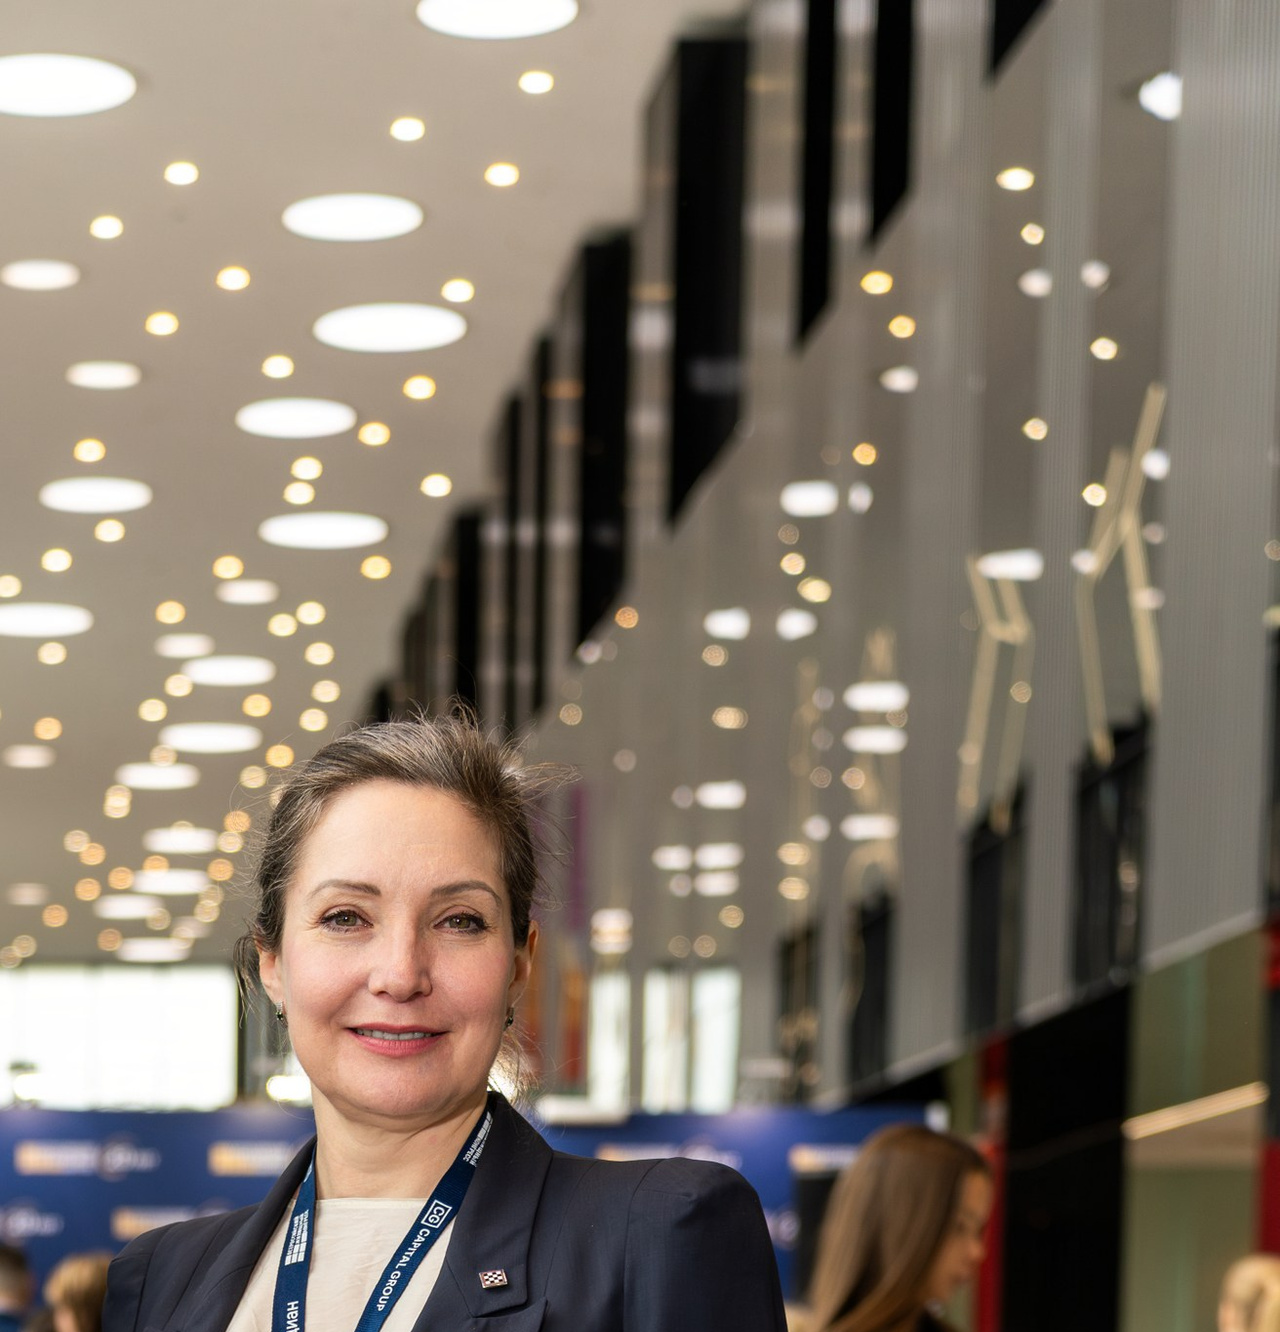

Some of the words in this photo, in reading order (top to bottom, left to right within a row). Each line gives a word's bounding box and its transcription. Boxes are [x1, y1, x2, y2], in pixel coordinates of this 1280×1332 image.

[428, 1206, 445, 1224] CG
[395, 1228, 430, 1269] CAPITAL
[376, 1270, 402, 1311] GROUP
